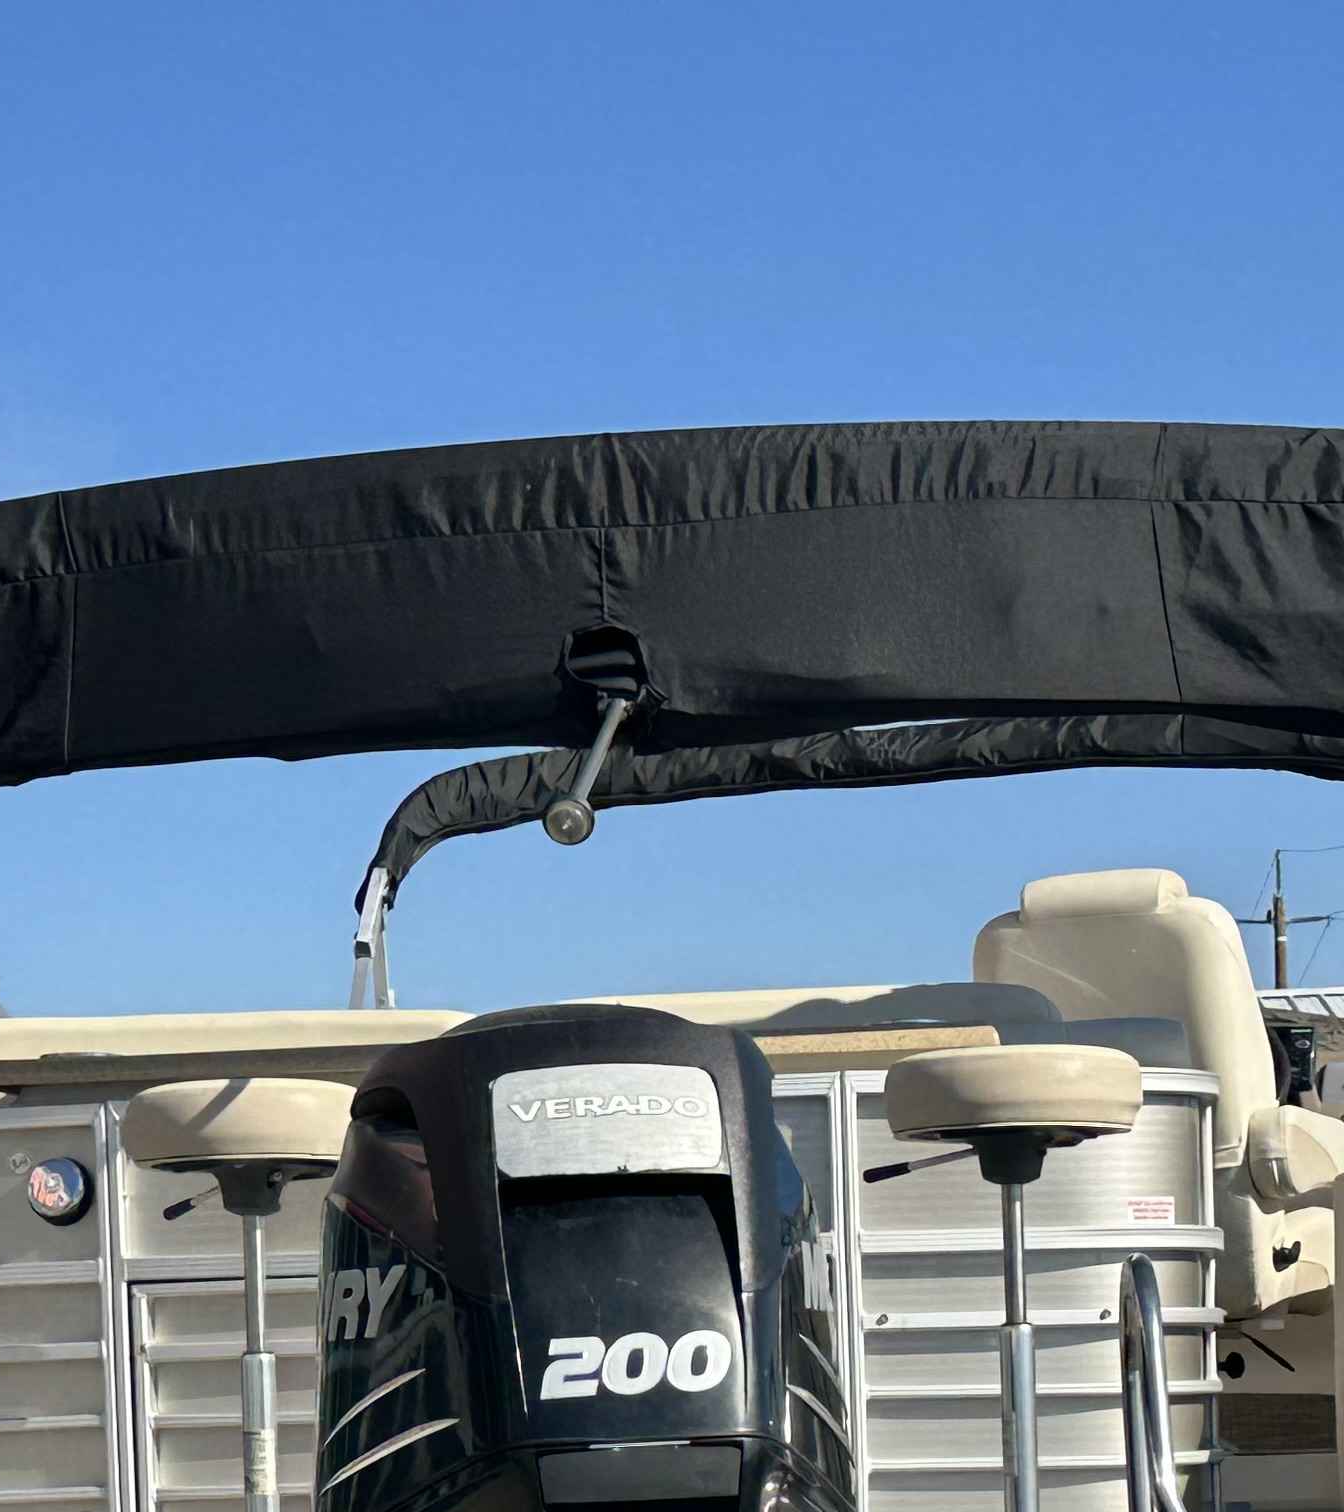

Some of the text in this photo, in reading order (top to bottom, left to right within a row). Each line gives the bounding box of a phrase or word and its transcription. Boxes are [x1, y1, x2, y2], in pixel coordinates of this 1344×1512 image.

[507, 1095, 709, 1124] VERADO
[324, 1264, 407, 1342] RY
[540, 1331, 733, 1401] 200
